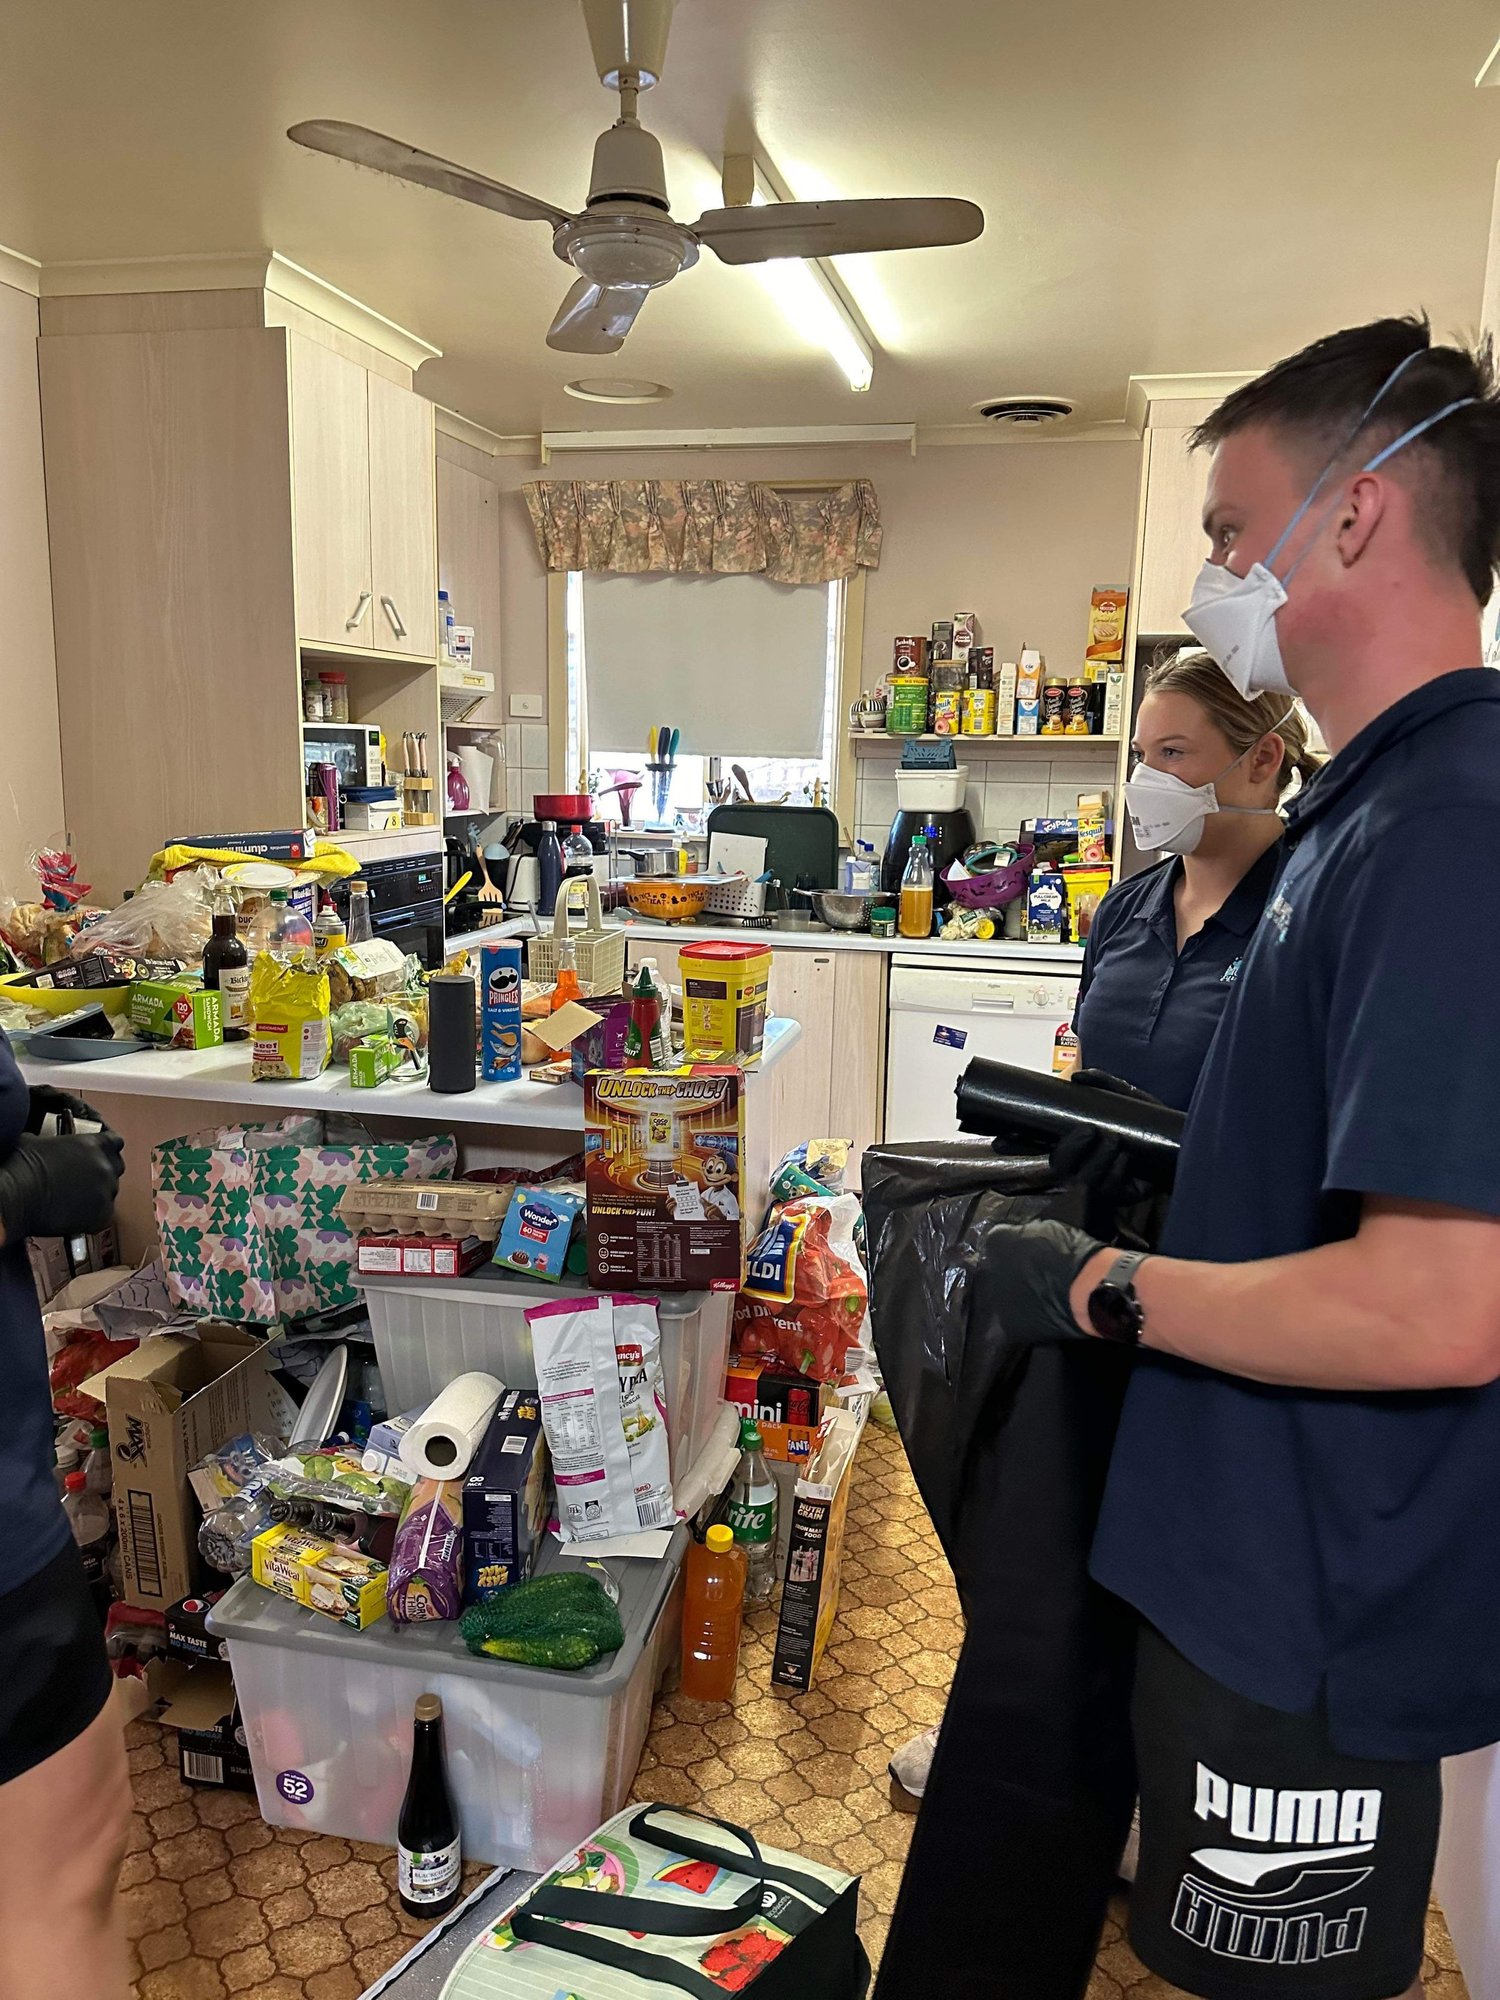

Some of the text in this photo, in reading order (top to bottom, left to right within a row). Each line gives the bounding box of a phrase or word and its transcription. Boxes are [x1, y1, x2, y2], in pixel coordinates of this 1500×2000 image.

[131, 993, 165, 1009] ARMADA
[488, 989, 519, 1006] PRINGLES
[131, 1003, 156, 1014] SANDWICH
[176, 1002, 188, 1012] 120
[205, 997, 213, 1031] SANDWICH
[211, 996, 221, 1043] ARMADA
[253, 1041, 278, 1049] Beef
[597, 1078, 657, 1098] UNLOCK
[675, 1078, 727, 1099] CHOC!
[524, 1208, 555, 1227] Wonder
[592, 1206, 622, 1216] UNLOCK
[636, 1208, 657, 1217] FUN!
[522, 1226, 533, 1234] 60
[712, 1281, 736, 1290] Kellogg's
[730, 1399, 782, 1424] mini
[761, 1421, 783, 1432] pack
[797, 1509, 824, 1521] GRAIN
[799, 1502, 826, 1514] NUTRI
[728, 1507, 767, 1530] rite
[804, 1531, 822, 1539] FOOD
[123, 1554, 133, 1580] CANS
[477, 1570, 509, 1588] EASY
[416, 1594, 428, 1620] CORN
[169, 1631, 208, 1648] MAX TASTE
[169, 1638, 207, 1655] NO SUGAR
[282, 1777, 309, 1798] 52
[1193, 1761, 1382, 1844] PUMA
